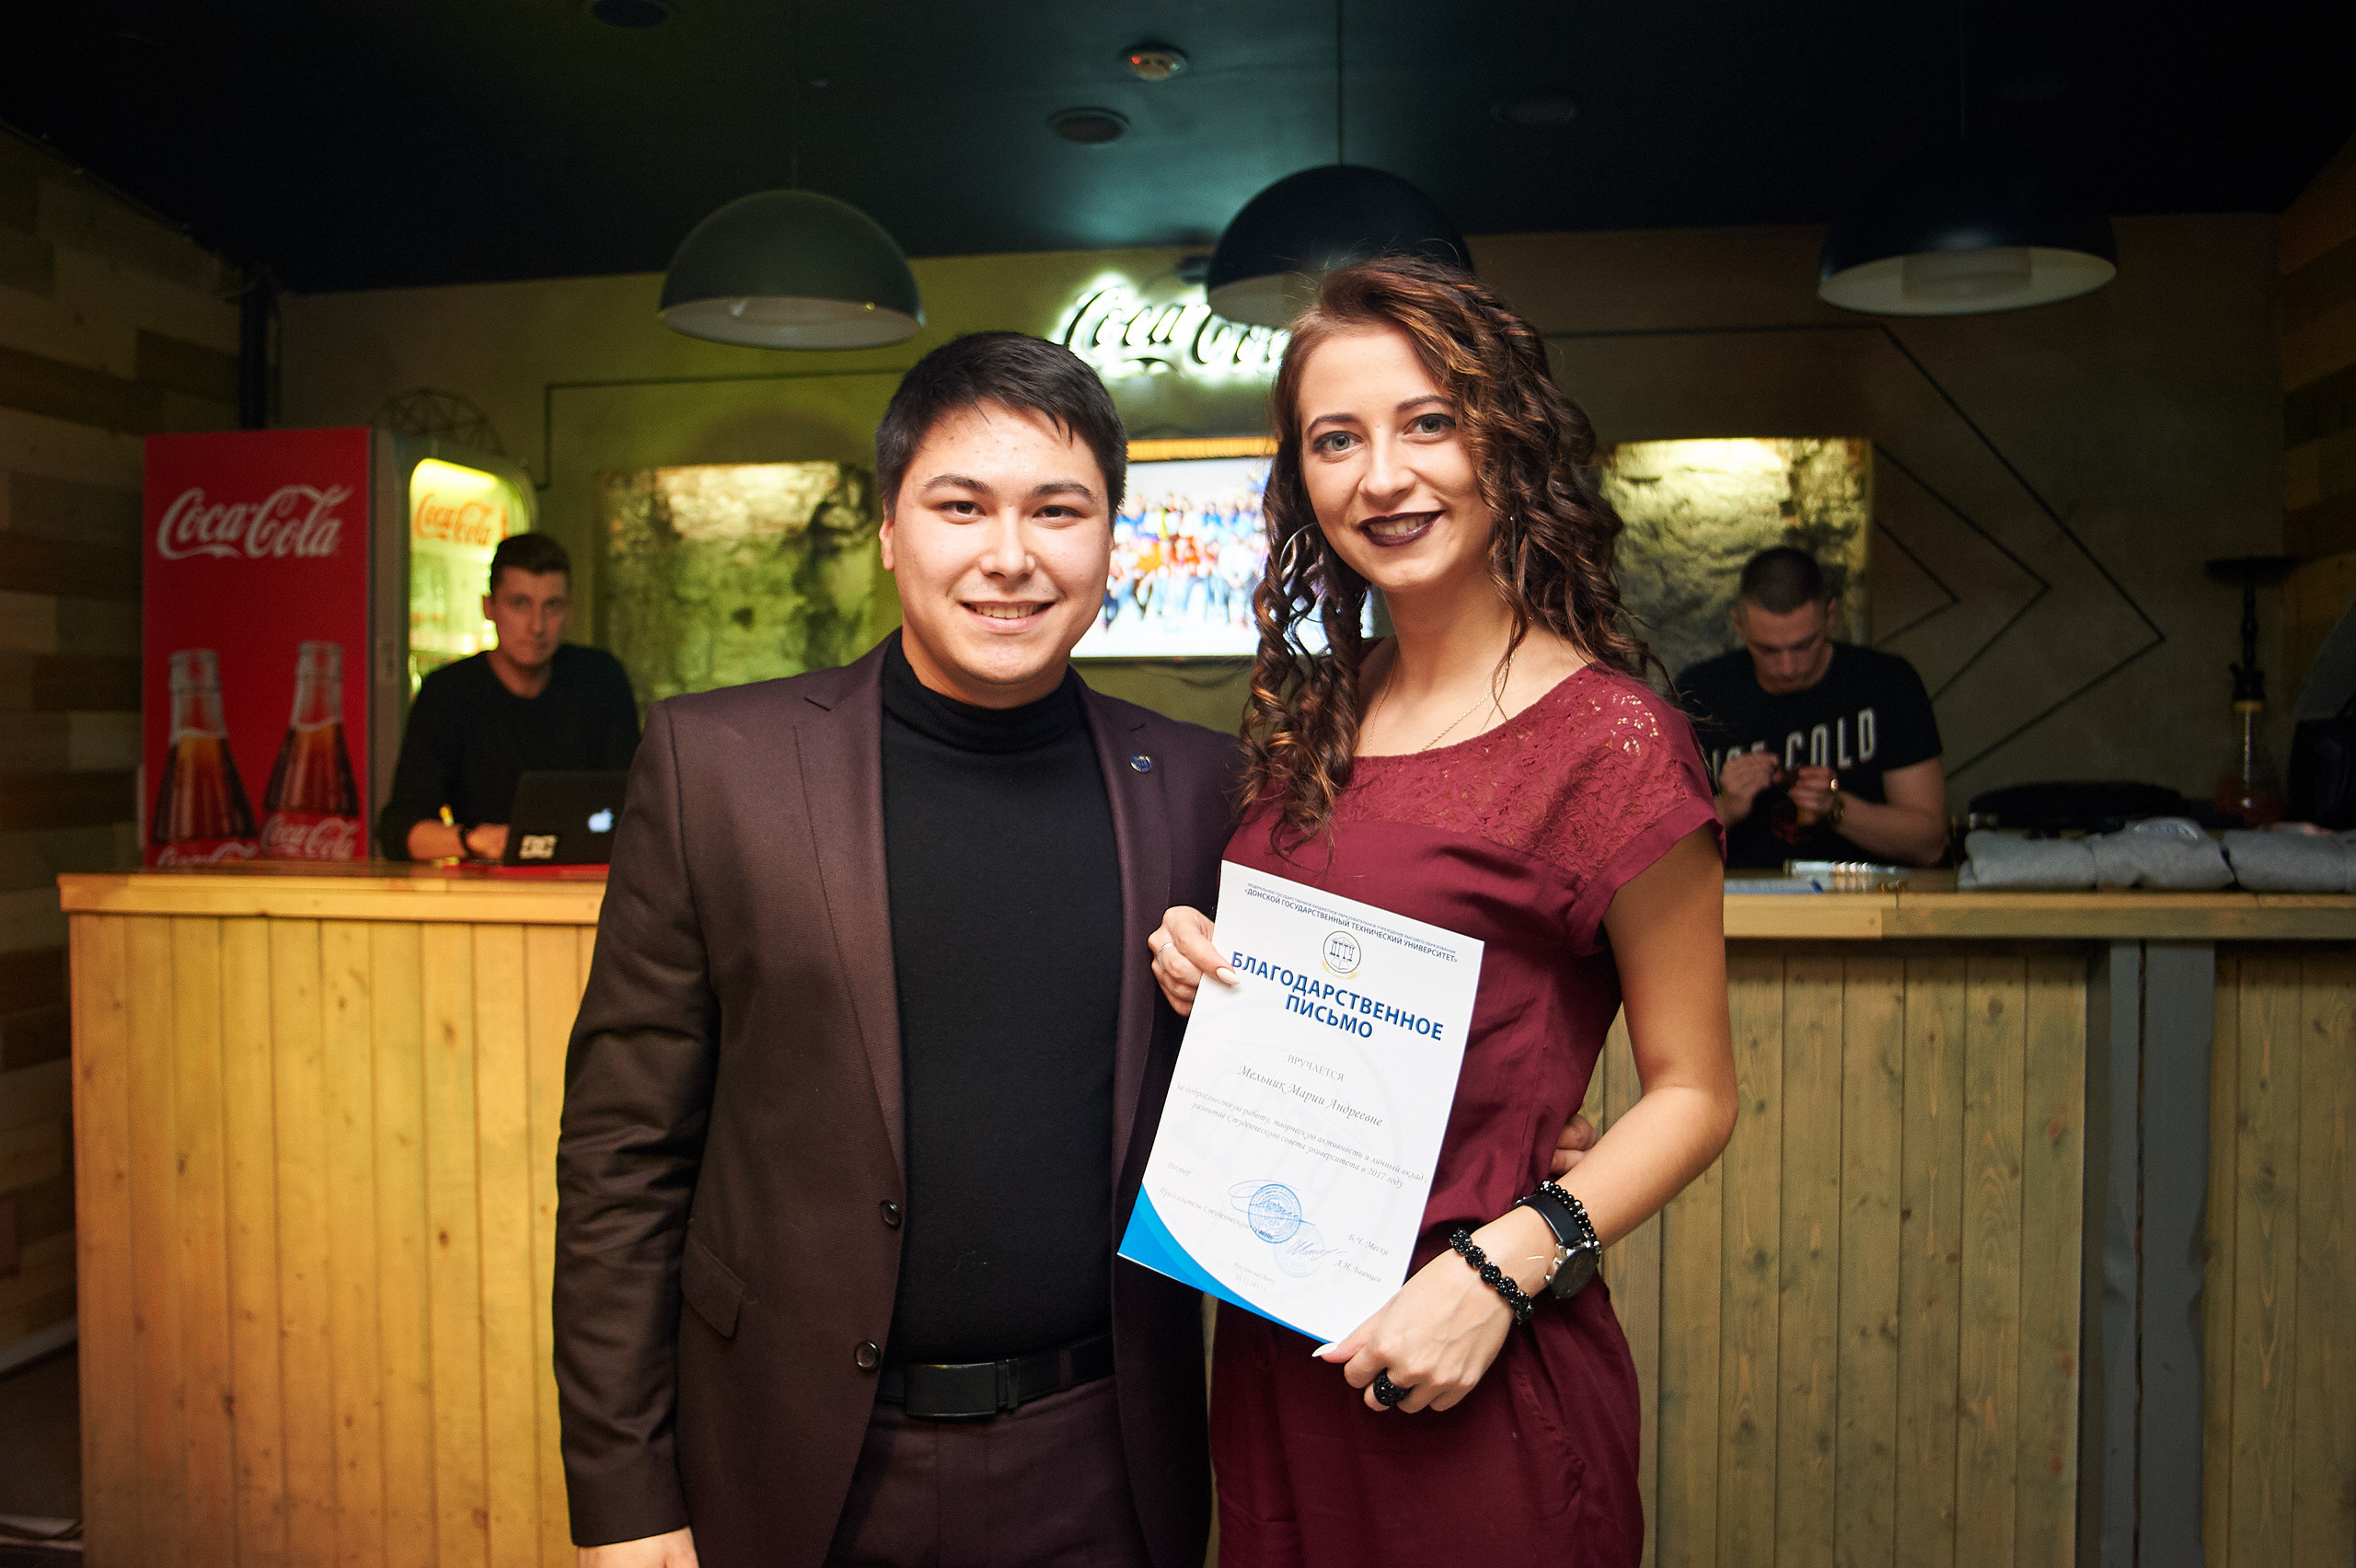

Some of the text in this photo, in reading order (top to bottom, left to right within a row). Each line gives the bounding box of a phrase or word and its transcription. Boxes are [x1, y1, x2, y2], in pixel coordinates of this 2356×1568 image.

[1058, 280, 1290, 377] Coca-Co
[156, 483, 355, 560] Coca-Cola
[414, 493, 494, 547] Coca-Cola
[1784, 707, 1877, 771] COLD
[1244, 887, 1458, 963] «ДОНСКОЙ ГОСУДАРСТВЕННЫЙ ТЕХНИЧЕСКИЙ УНИВЕРСИТЕТ»
[1275, 890, 1311, 907] ГОСУДАРСТВЕННОЕ
[1377, 924, 1404, 938] УЧРЕЖДЕНИЕ
[1404, 934, 1425, 945] ВЫСШЕГО
[1425, 940, 1456, 954] ОБРАЗОВАНИЯ
[1230, 951, 1444, 1041] БЛАГОДАРСТВЕННОЕ
[1285, 994, 1373, 1039] ПИСЬМО
[1237, 1066, 1383, 1126] Мельник Марии Андреевне
[1288, 1055, 1345, 1081] ВРУЧАЕТСЯ
[1184, 1086, 1242, 1112] добросовестную
[1273, 1119, 1316, 1141] творческую
[1317, 1136, 1363, 1159] активность
[1370, 1157, 1401, 1173] личный
[1191, 1102, 1227, 1119] развитие
[1227, 1113, 1280, 1139] Студенческого
[1280, 1134, 1306, 1149] совета
[1307, 1144, 1359, 1170] университета
[1367, 1167, 1387, 1180] 2017
[1386, 1175, 1404, 1189] году
